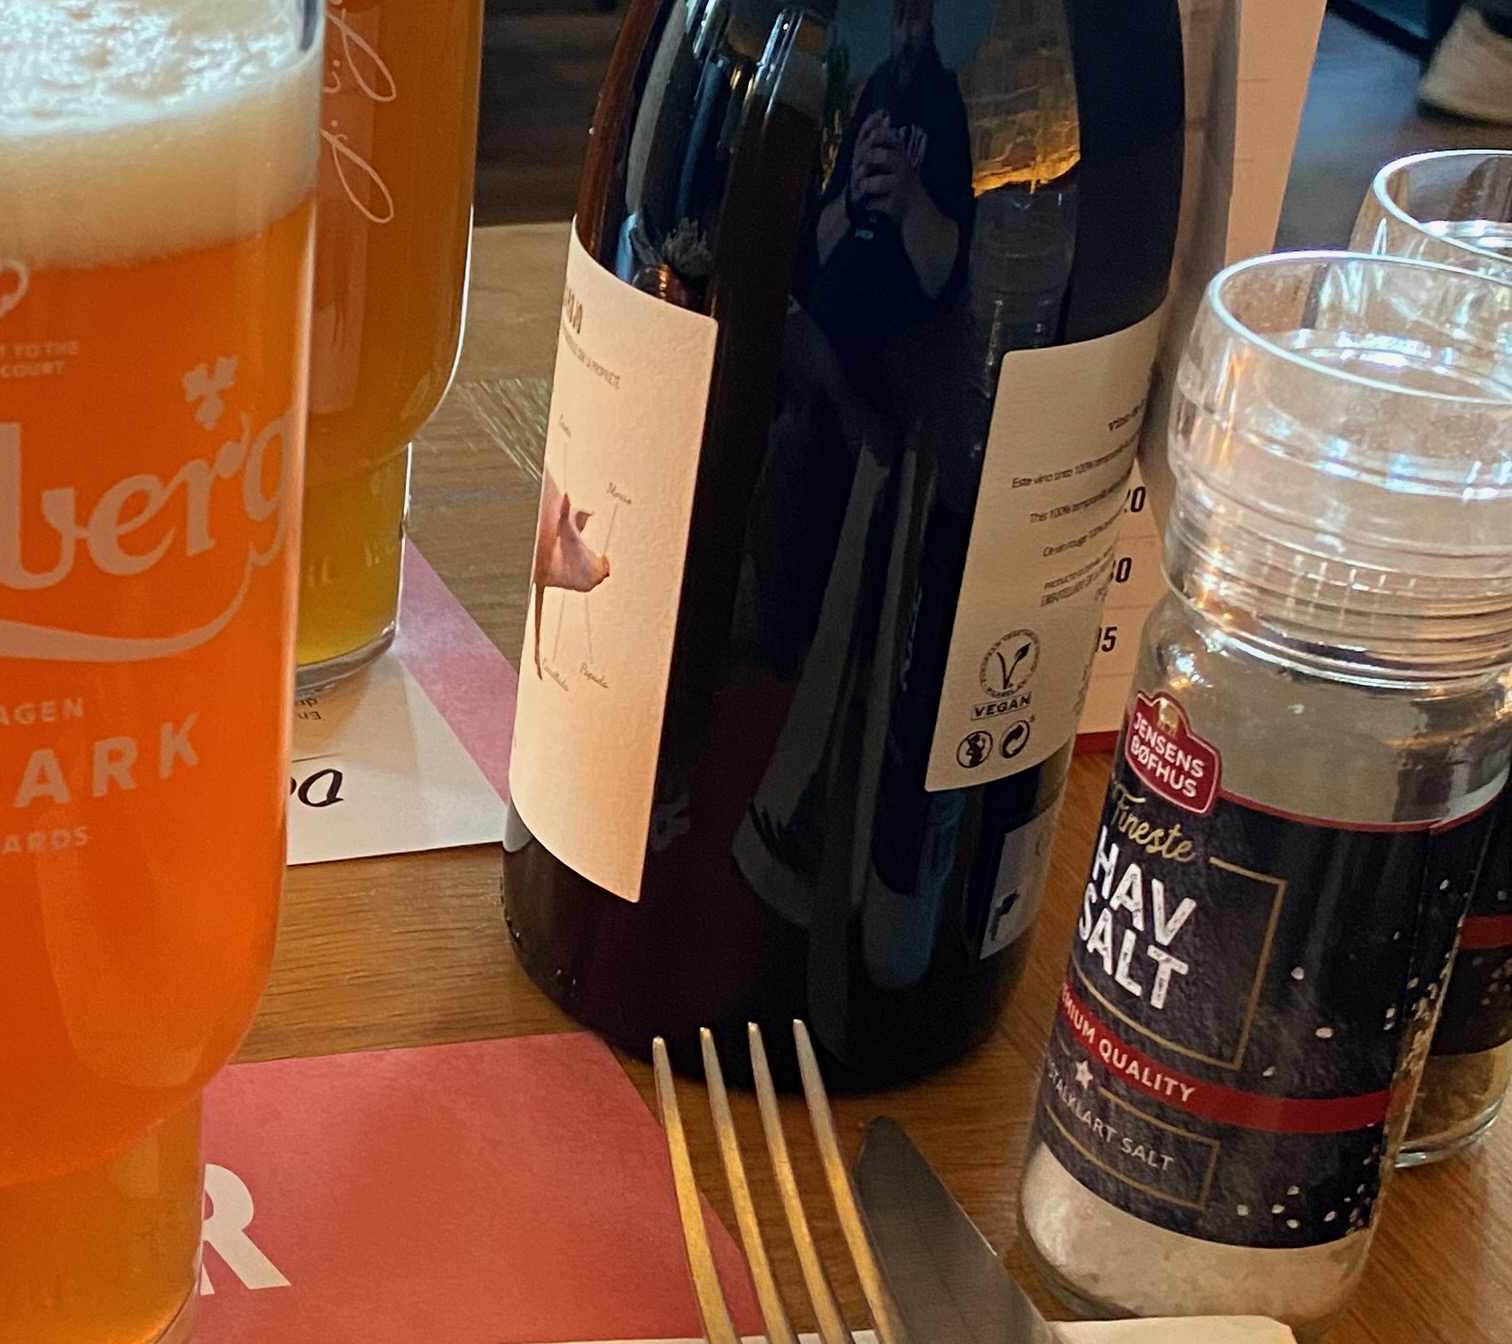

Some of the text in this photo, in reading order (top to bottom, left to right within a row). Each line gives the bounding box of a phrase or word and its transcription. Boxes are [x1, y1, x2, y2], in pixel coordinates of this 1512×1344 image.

[1124, 485, 1146, 513] 0
[1110, 556, 1132, 583] 0
[974, 693, 1031, 718] VEGAN
[1129, 733, 1198, 799] BØFHUS
[1134, 712, 1205, 779] JENSENS
[289, 768, 344, 808] D
[1110, 786, 1196, 863] Fineste
[1092, 825, 1197, 947] HAV
[1078, 882, 1190, 1010] SALT
[1098, 1038, 1197, 1103] QUALITY
[1120, 1137, 1175, 1172] SALT
